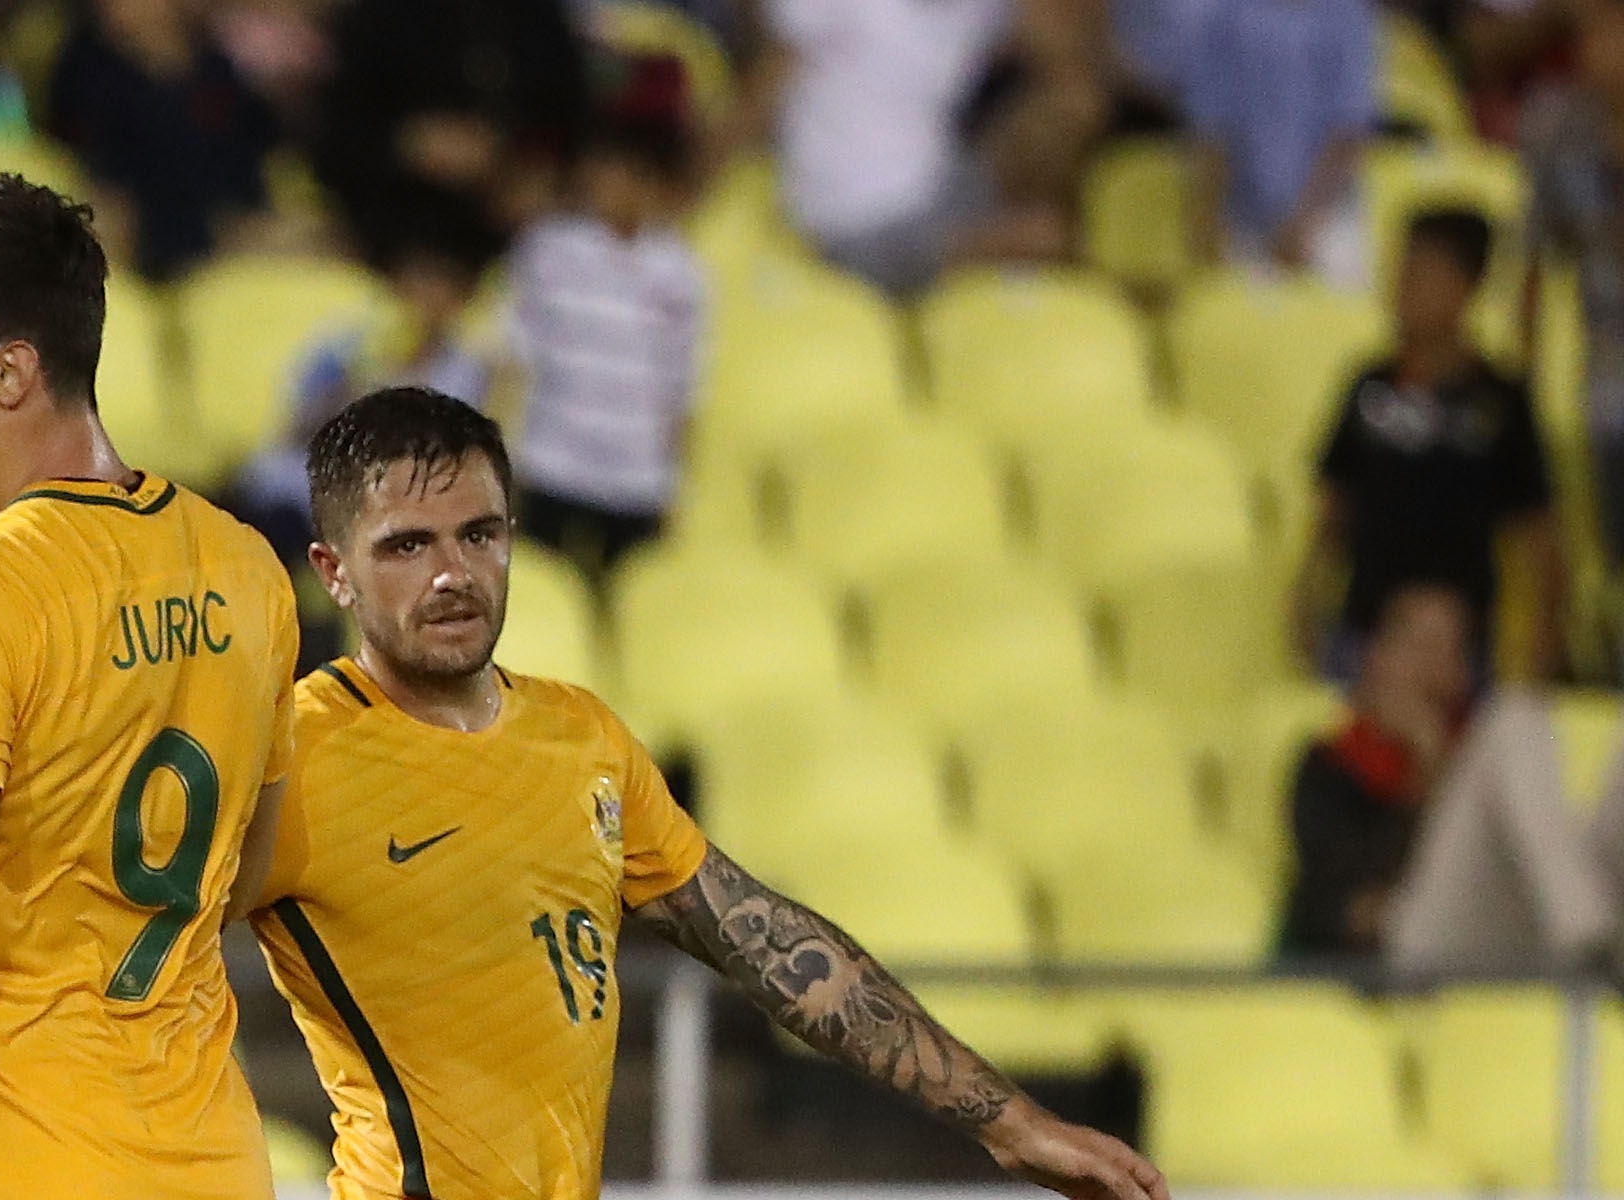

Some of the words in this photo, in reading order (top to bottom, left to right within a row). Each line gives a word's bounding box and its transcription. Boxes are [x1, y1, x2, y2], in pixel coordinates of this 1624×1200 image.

[111, 589, 232, 670] JURIC
[105, 727, 219, 1001] 9
[530, 908, 607, 1025] 19
